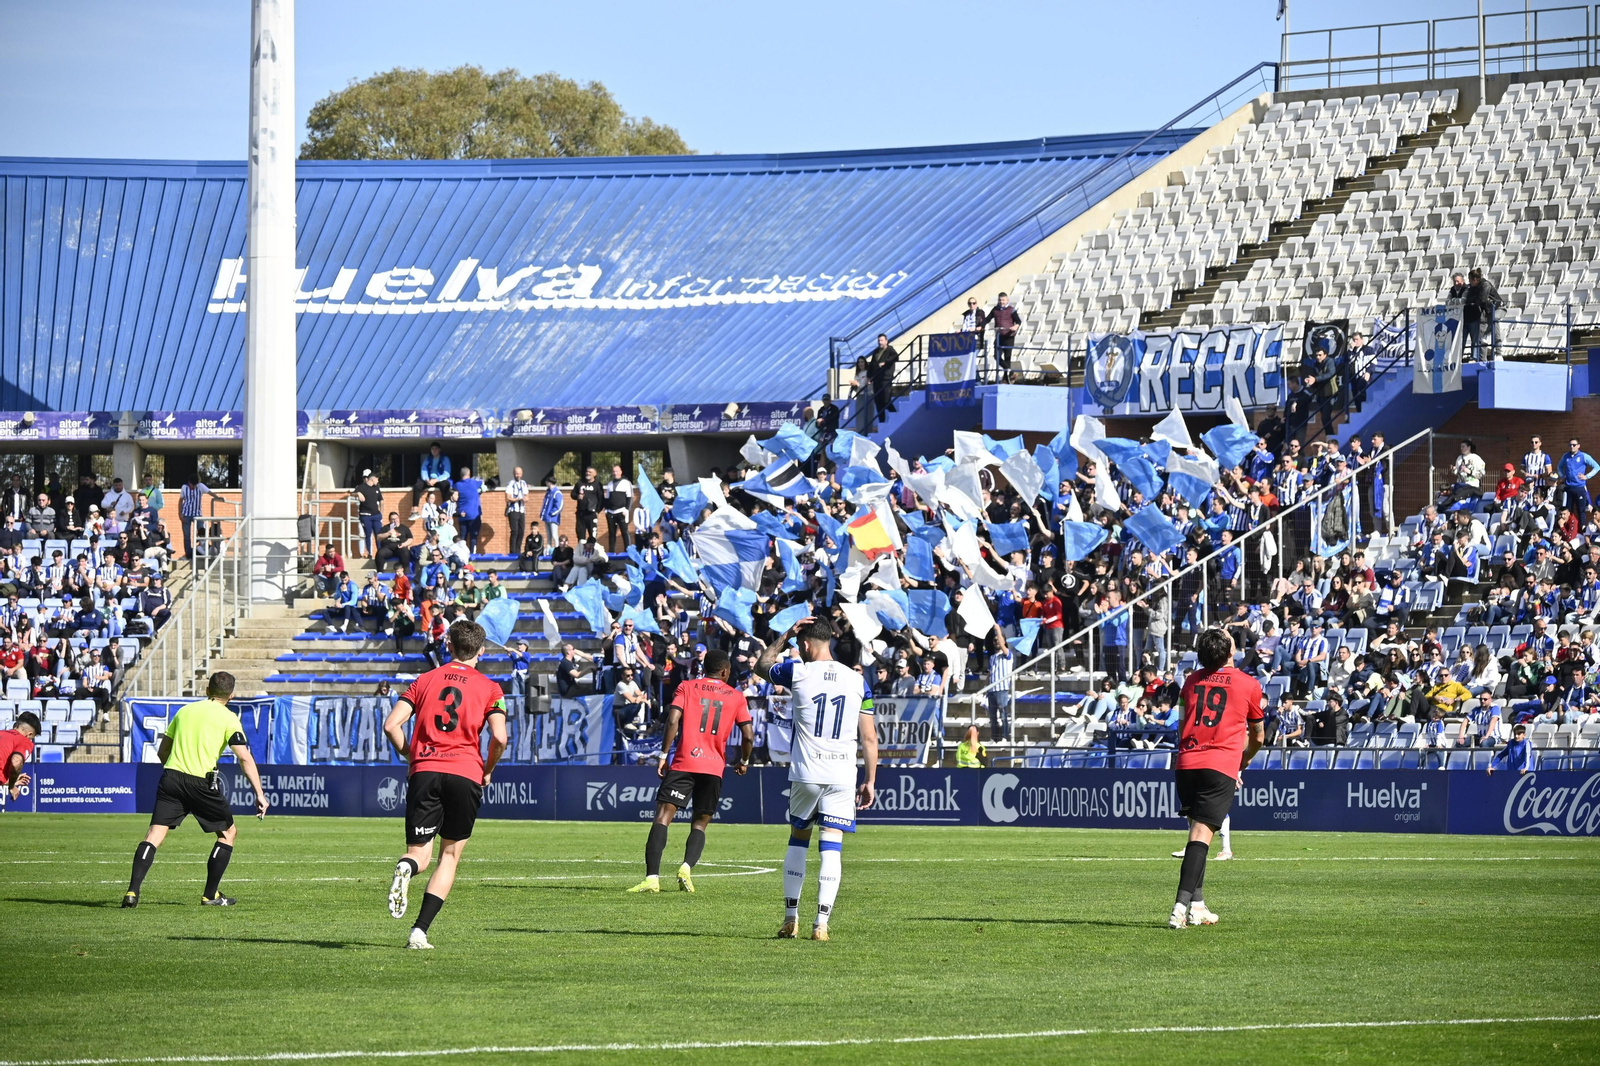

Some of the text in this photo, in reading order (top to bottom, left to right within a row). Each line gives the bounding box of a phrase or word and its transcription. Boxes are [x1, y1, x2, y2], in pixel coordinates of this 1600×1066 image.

[1138, 324, 1286, 412] RECRE
[616, 414, 636, 422] alter
[673, 412, 690, 421] alter
[770, 409, 788, 418] alter
[59, 419, 82, 428] alter
[140, 419, 162, 428] alter
[195, 419, 218, 428] alter
[567, 415, 586, 423] alter
[720, 418, 751, 427] enersun
[567, 423, 601, 431] enersun
[616, 422, 651, 431] enersun
[672, 420, 704, 429] enersun
[59, 428, 98, 436] enersun
[195, 427, 235, 436] enersun
[383, 425, 420, 434] enersun
[443, 425, 480, 434] enersun
[444, 673, 468, 684] YUSTE
[823, 671, 838, 682] CAYE
[1224, 676, 1232, 685] R.
[434, 686, 463, 733] 3
[1194, 685, 1228, 728] 19
[699, 698, 724, 735] 11
[811, 693, 846, 740] 11
[234, 773, 325, 790] HOEL MARTÍN
[79, 786, 103, 794] FÚTBOL
[104, 786, 133, 794] ESPAÑOL
[487, 782, 538, 804] CINTA S.L.
[1347, 781, 1421, 808] Huelva
[230, 791, 329, 808] ALOSO PINZÓN
[1019, 786, 1109, 817] COPIADORAS
[1273, 810, 1299, 822] original
[1394, 811, 1421, 823] original
[823, 815, 852, 827] ROMERO
